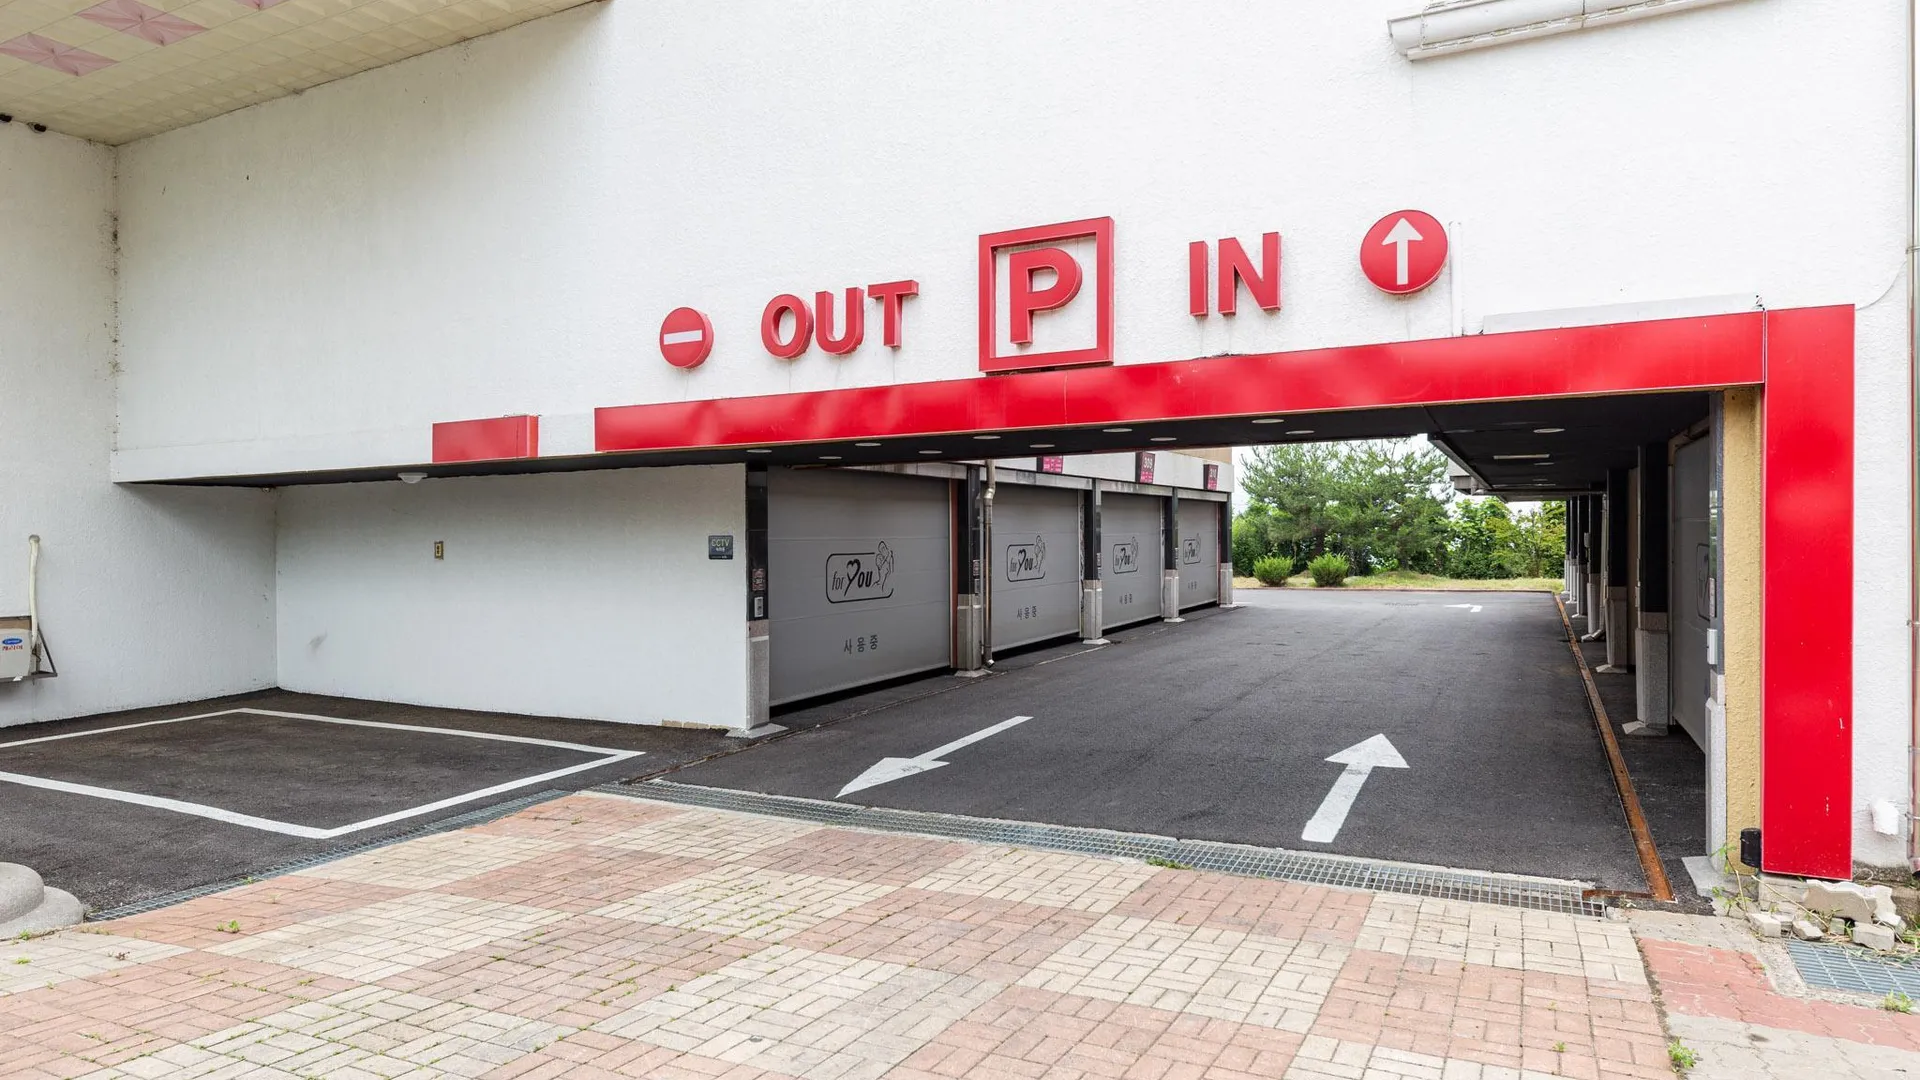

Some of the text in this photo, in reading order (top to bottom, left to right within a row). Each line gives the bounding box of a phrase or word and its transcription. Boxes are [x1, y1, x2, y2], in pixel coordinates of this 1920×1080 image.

[1008, 247, 1082, 346] P
[1189, 232, 1281, 318] IN
[761, 279, 918, 360] OUT
[711, 539, 730, 547] CCTV
[831, 571, 845, 591] for
